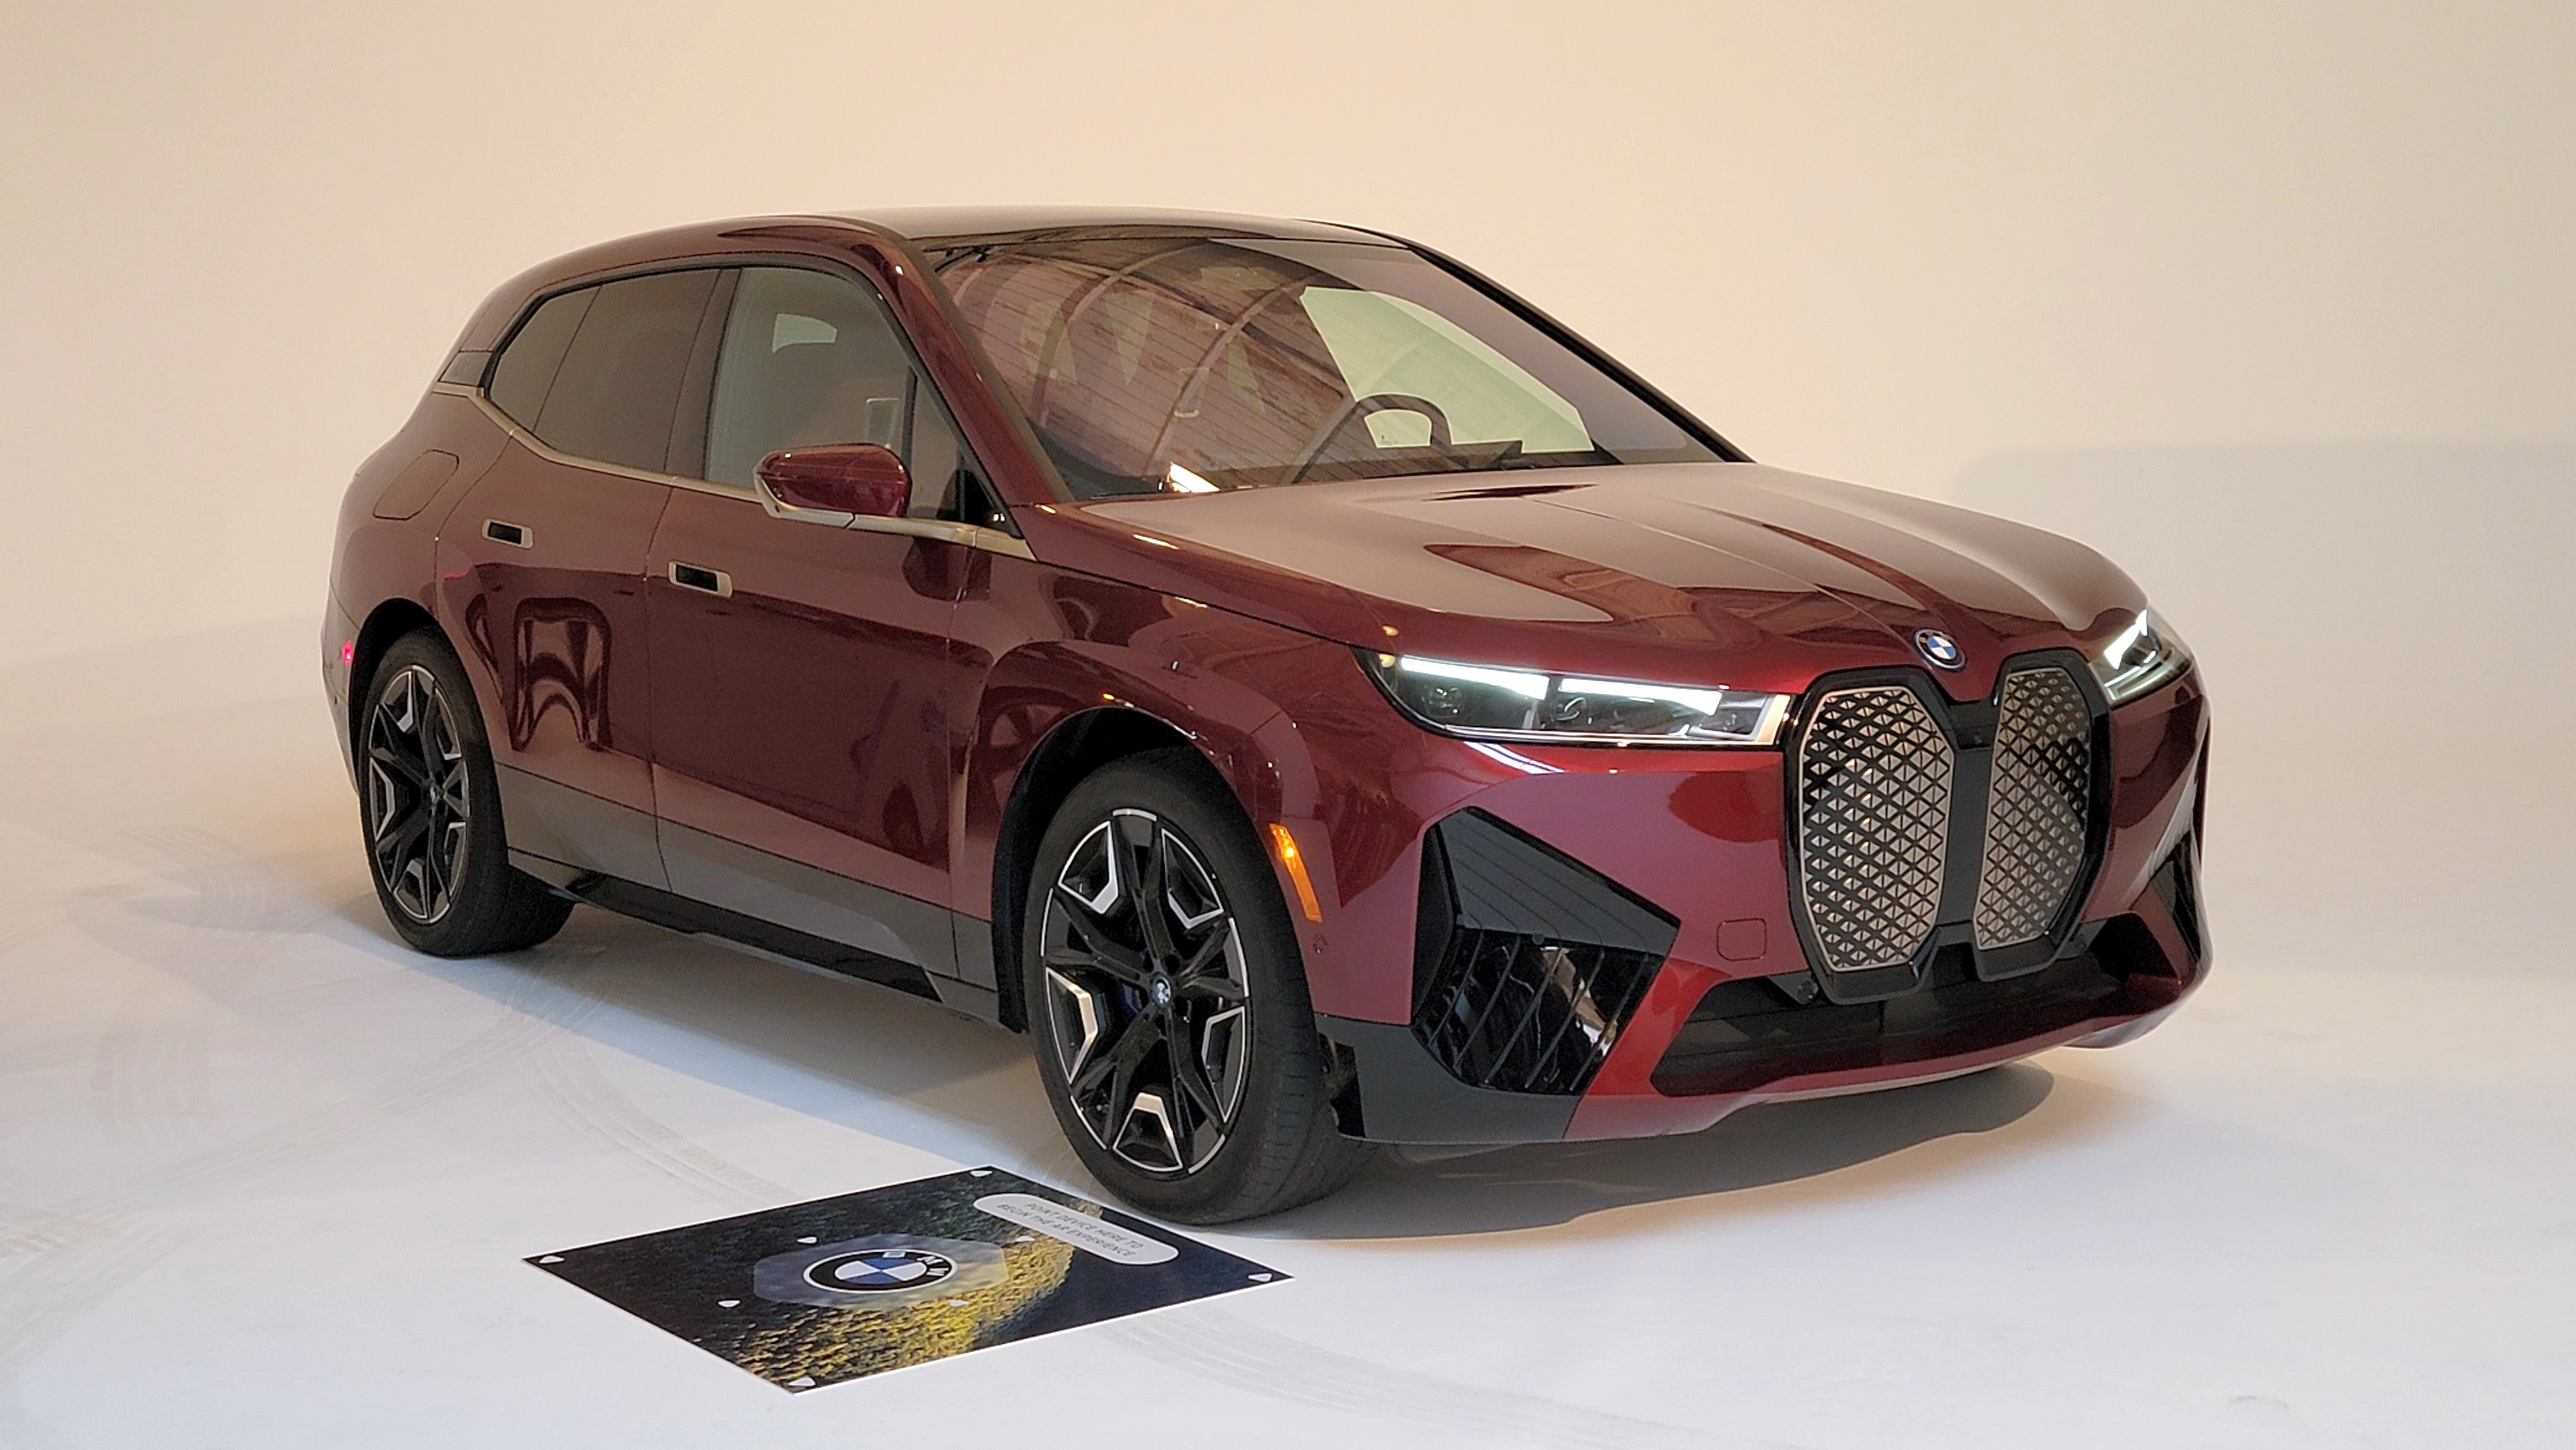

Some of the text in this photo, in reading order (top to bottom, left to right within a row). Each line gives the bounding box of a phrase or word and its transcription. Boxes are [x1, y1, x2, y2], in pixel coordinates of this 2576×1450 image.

[996, 1204, 1137, 1257] BEGIN THE AR EXPERIENCE
[1023, 1203, 1144, 1249] POINT DEVICE HERE TO
